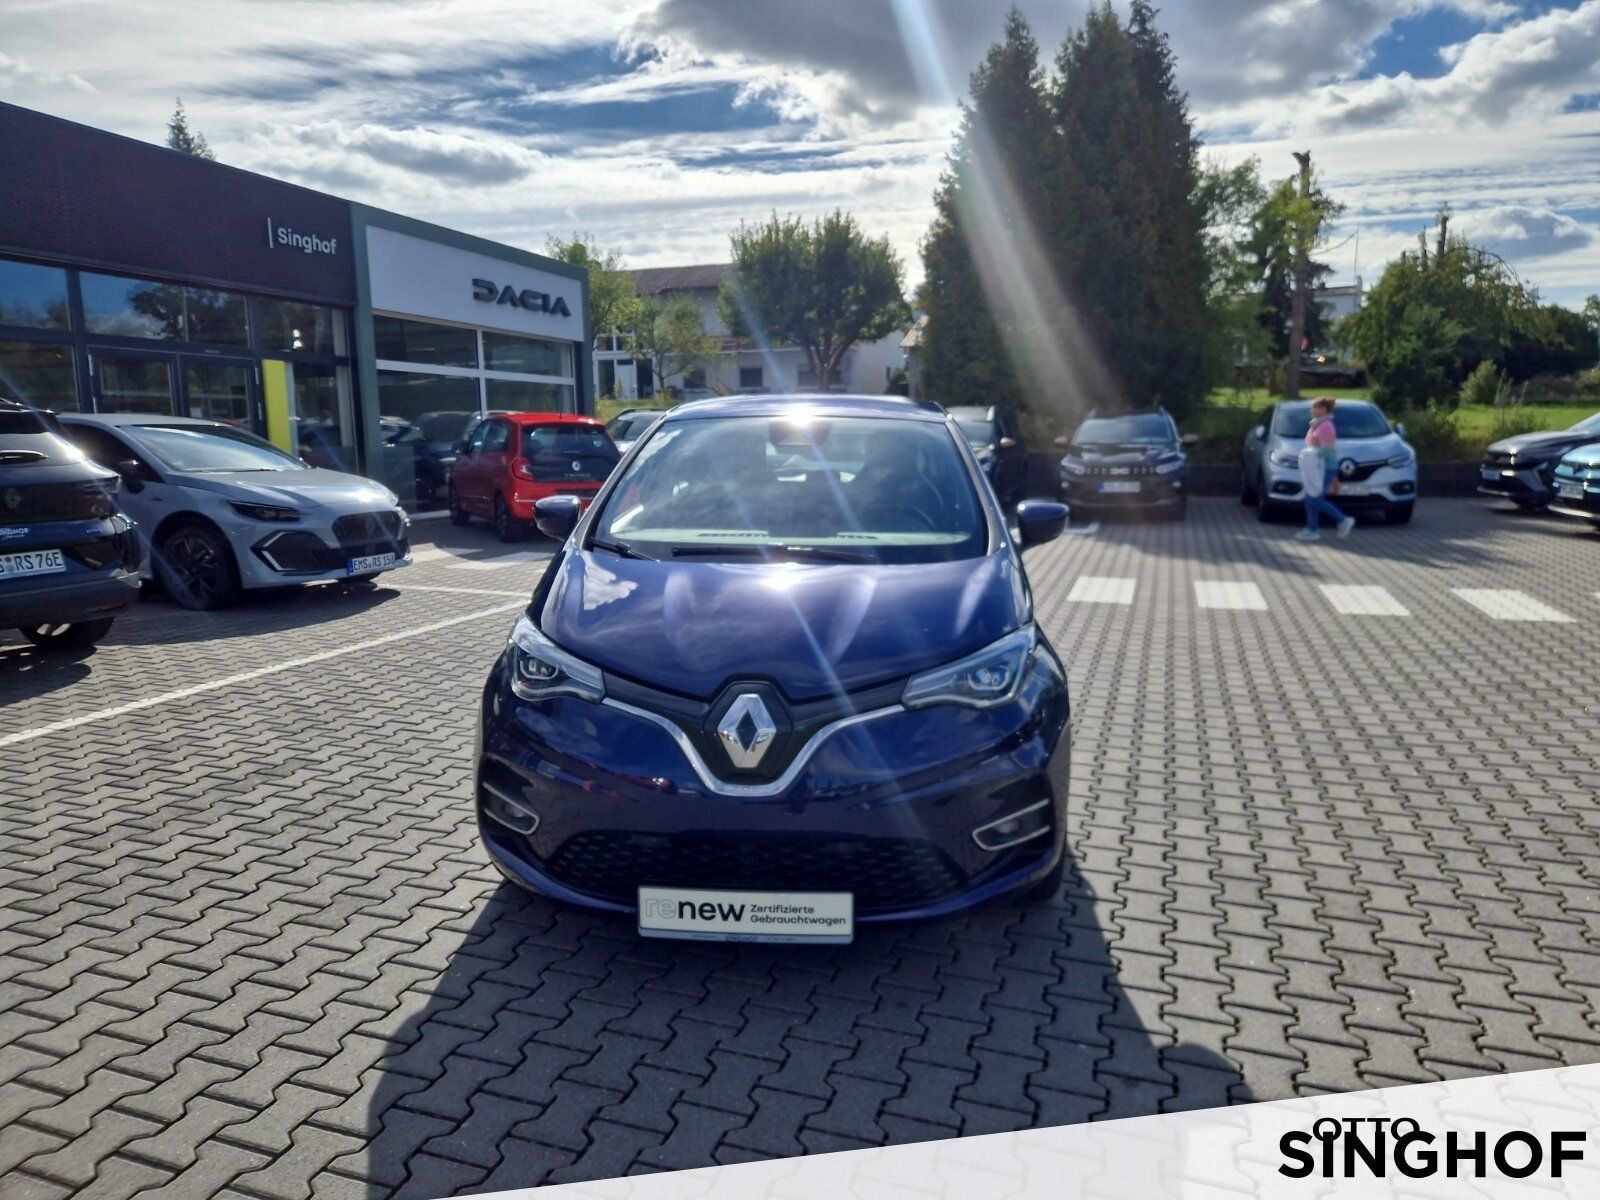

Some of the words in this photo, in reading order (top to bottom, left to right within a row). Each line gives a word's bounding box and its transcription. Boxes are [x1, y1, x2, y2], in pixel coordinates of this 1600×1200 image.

[277, 227, 337, 254] Singhof
[472, 278, 572, 317] DACIA
[35, 551, 63, 569] 76E
[645, 898, 746, 922] renew
[750, 904, 815, 914] Zertifizierte
[750, 914, 846, 927] Gebrauchtwagen
